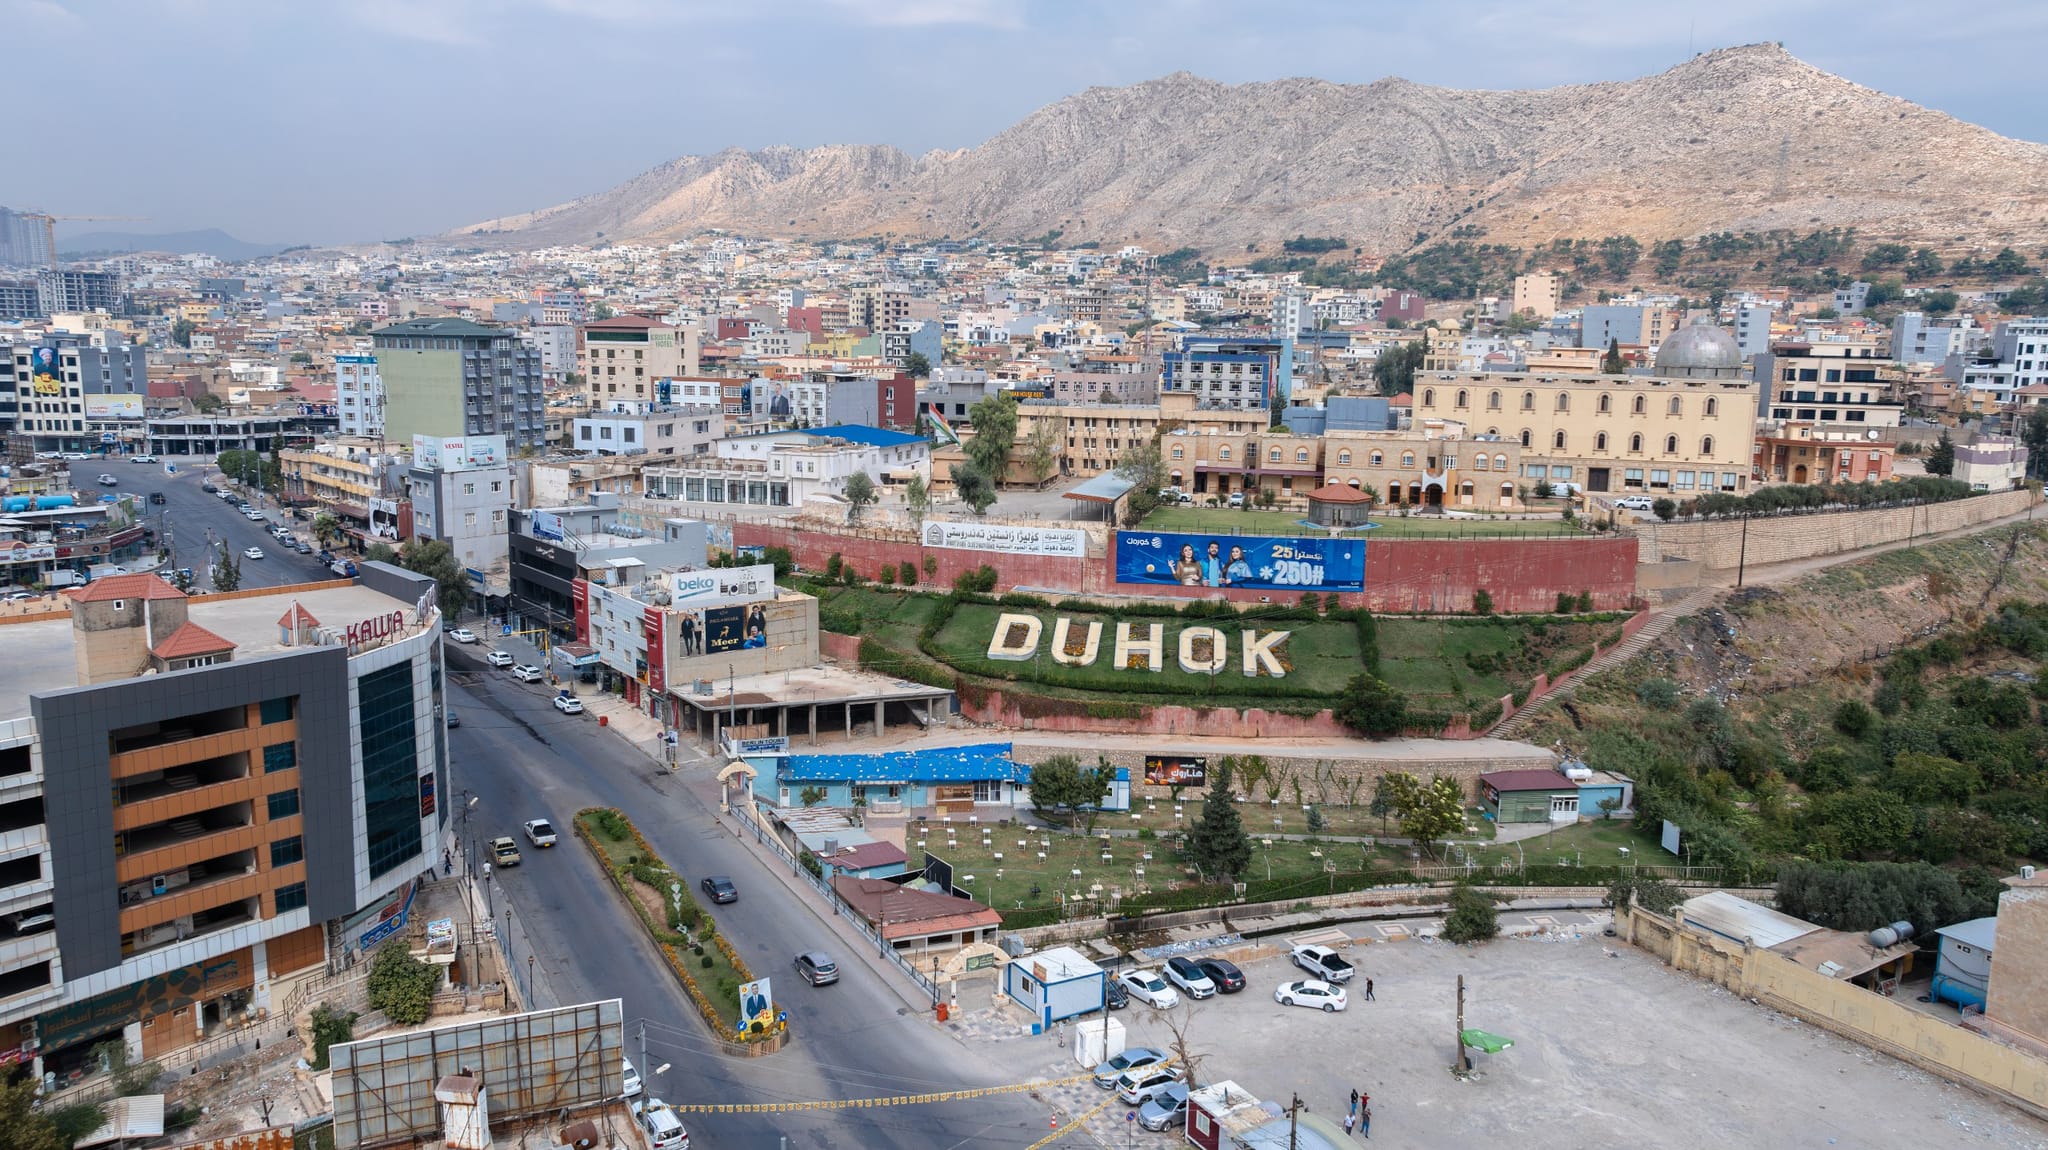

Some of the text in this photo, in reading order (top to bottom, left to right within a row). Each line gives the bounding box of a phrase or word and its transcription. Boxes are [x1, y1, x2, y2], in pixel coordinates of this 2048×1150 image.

[1271, 545, 1293, 558] 25
[678, 577, 714, 590] beko
[346, 610, 404, 648] KAWA
[711, 638, 739, 648] Meer
[987, 613, 1291, 678] DUHOK
